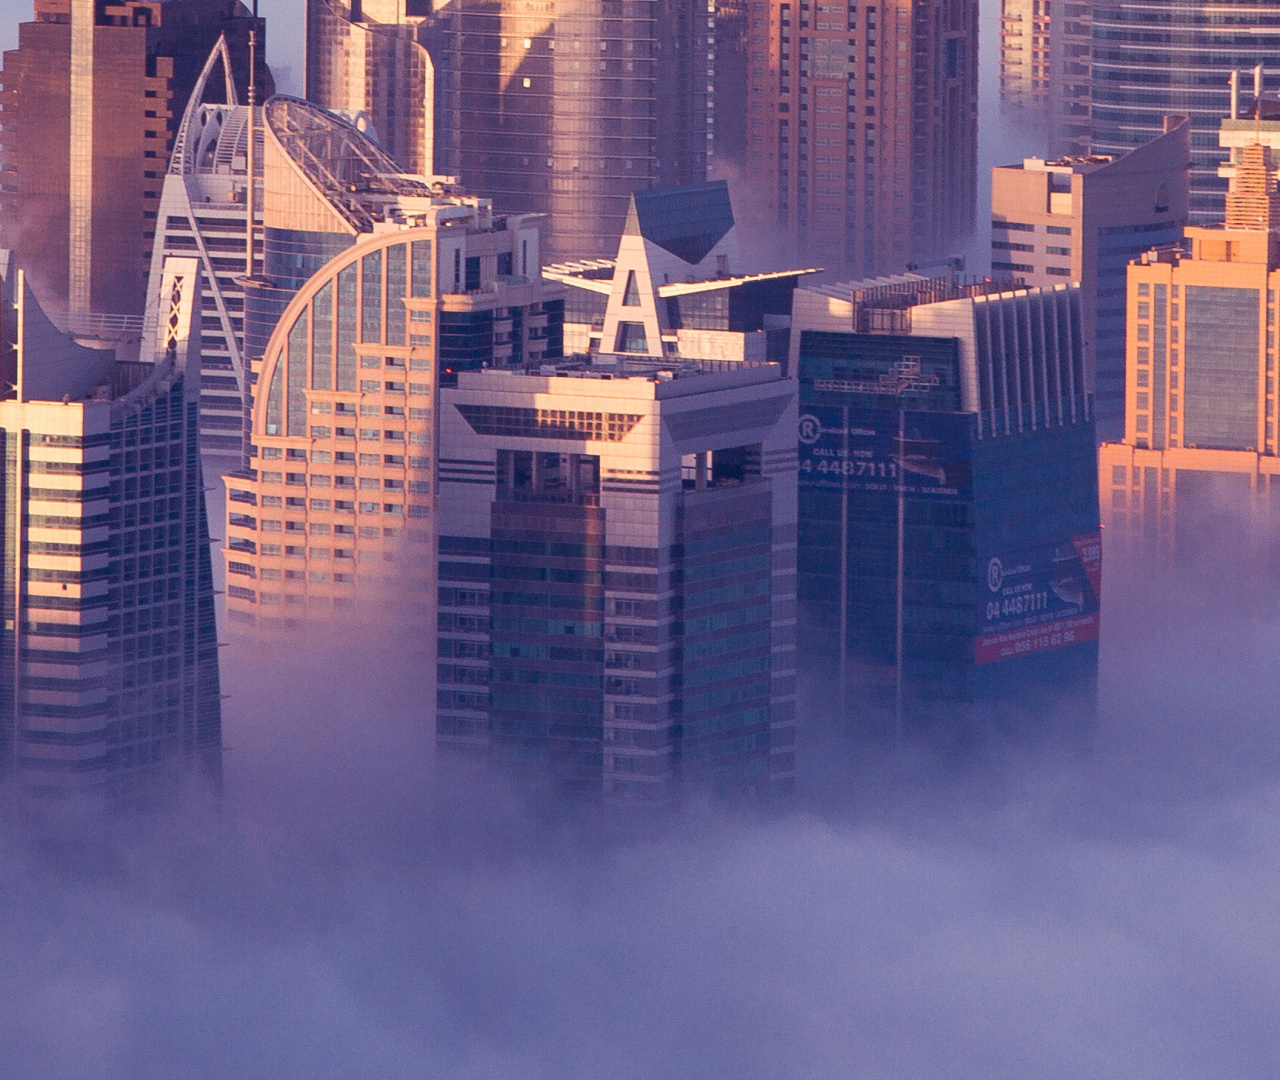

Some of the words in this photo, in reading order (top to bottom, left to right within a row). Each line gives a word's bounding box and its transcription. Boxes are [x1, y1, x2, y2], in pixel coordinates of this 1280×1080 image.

[813, 448, 835, 457] CALL
[853, 450, 873, 458] NOW
[816, 459, 897, 478] 4487111
[986, 601, 1000, 620] 04
[1002, 591, 1047, 617] 4487111
